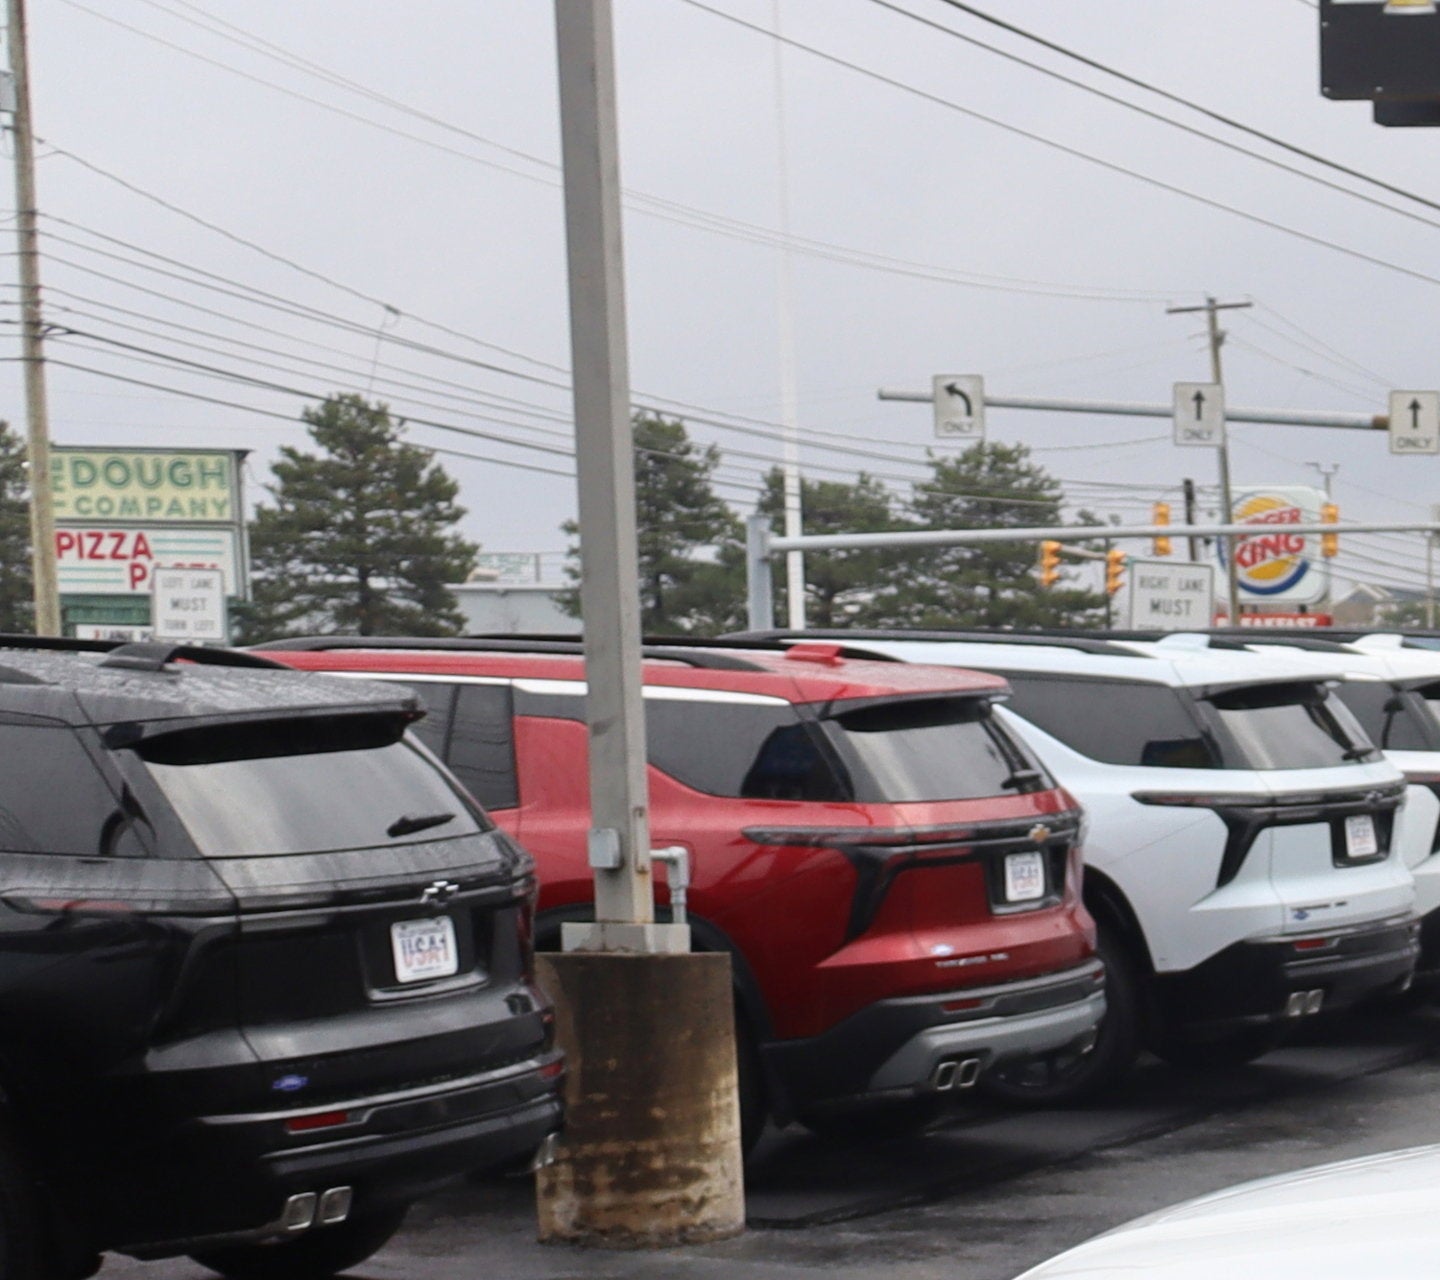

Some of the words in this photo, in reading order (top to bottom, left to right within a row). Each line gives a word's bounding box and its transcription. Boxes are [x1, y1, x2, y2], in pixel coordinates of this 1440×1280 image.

[1397, 437, 1432, 449] ONLY
[70, 457, 227, 489] DOUGH
[74, 495, 229, 516] COMPANY
[55, 531, 153, 560] PIZZA
[1178, 577, 1205, 591] LANE
[170, 597, 207, 611] MUST
[1151, 599, 1192, 615] MUST
[401, 934, 450, 968] USA1
